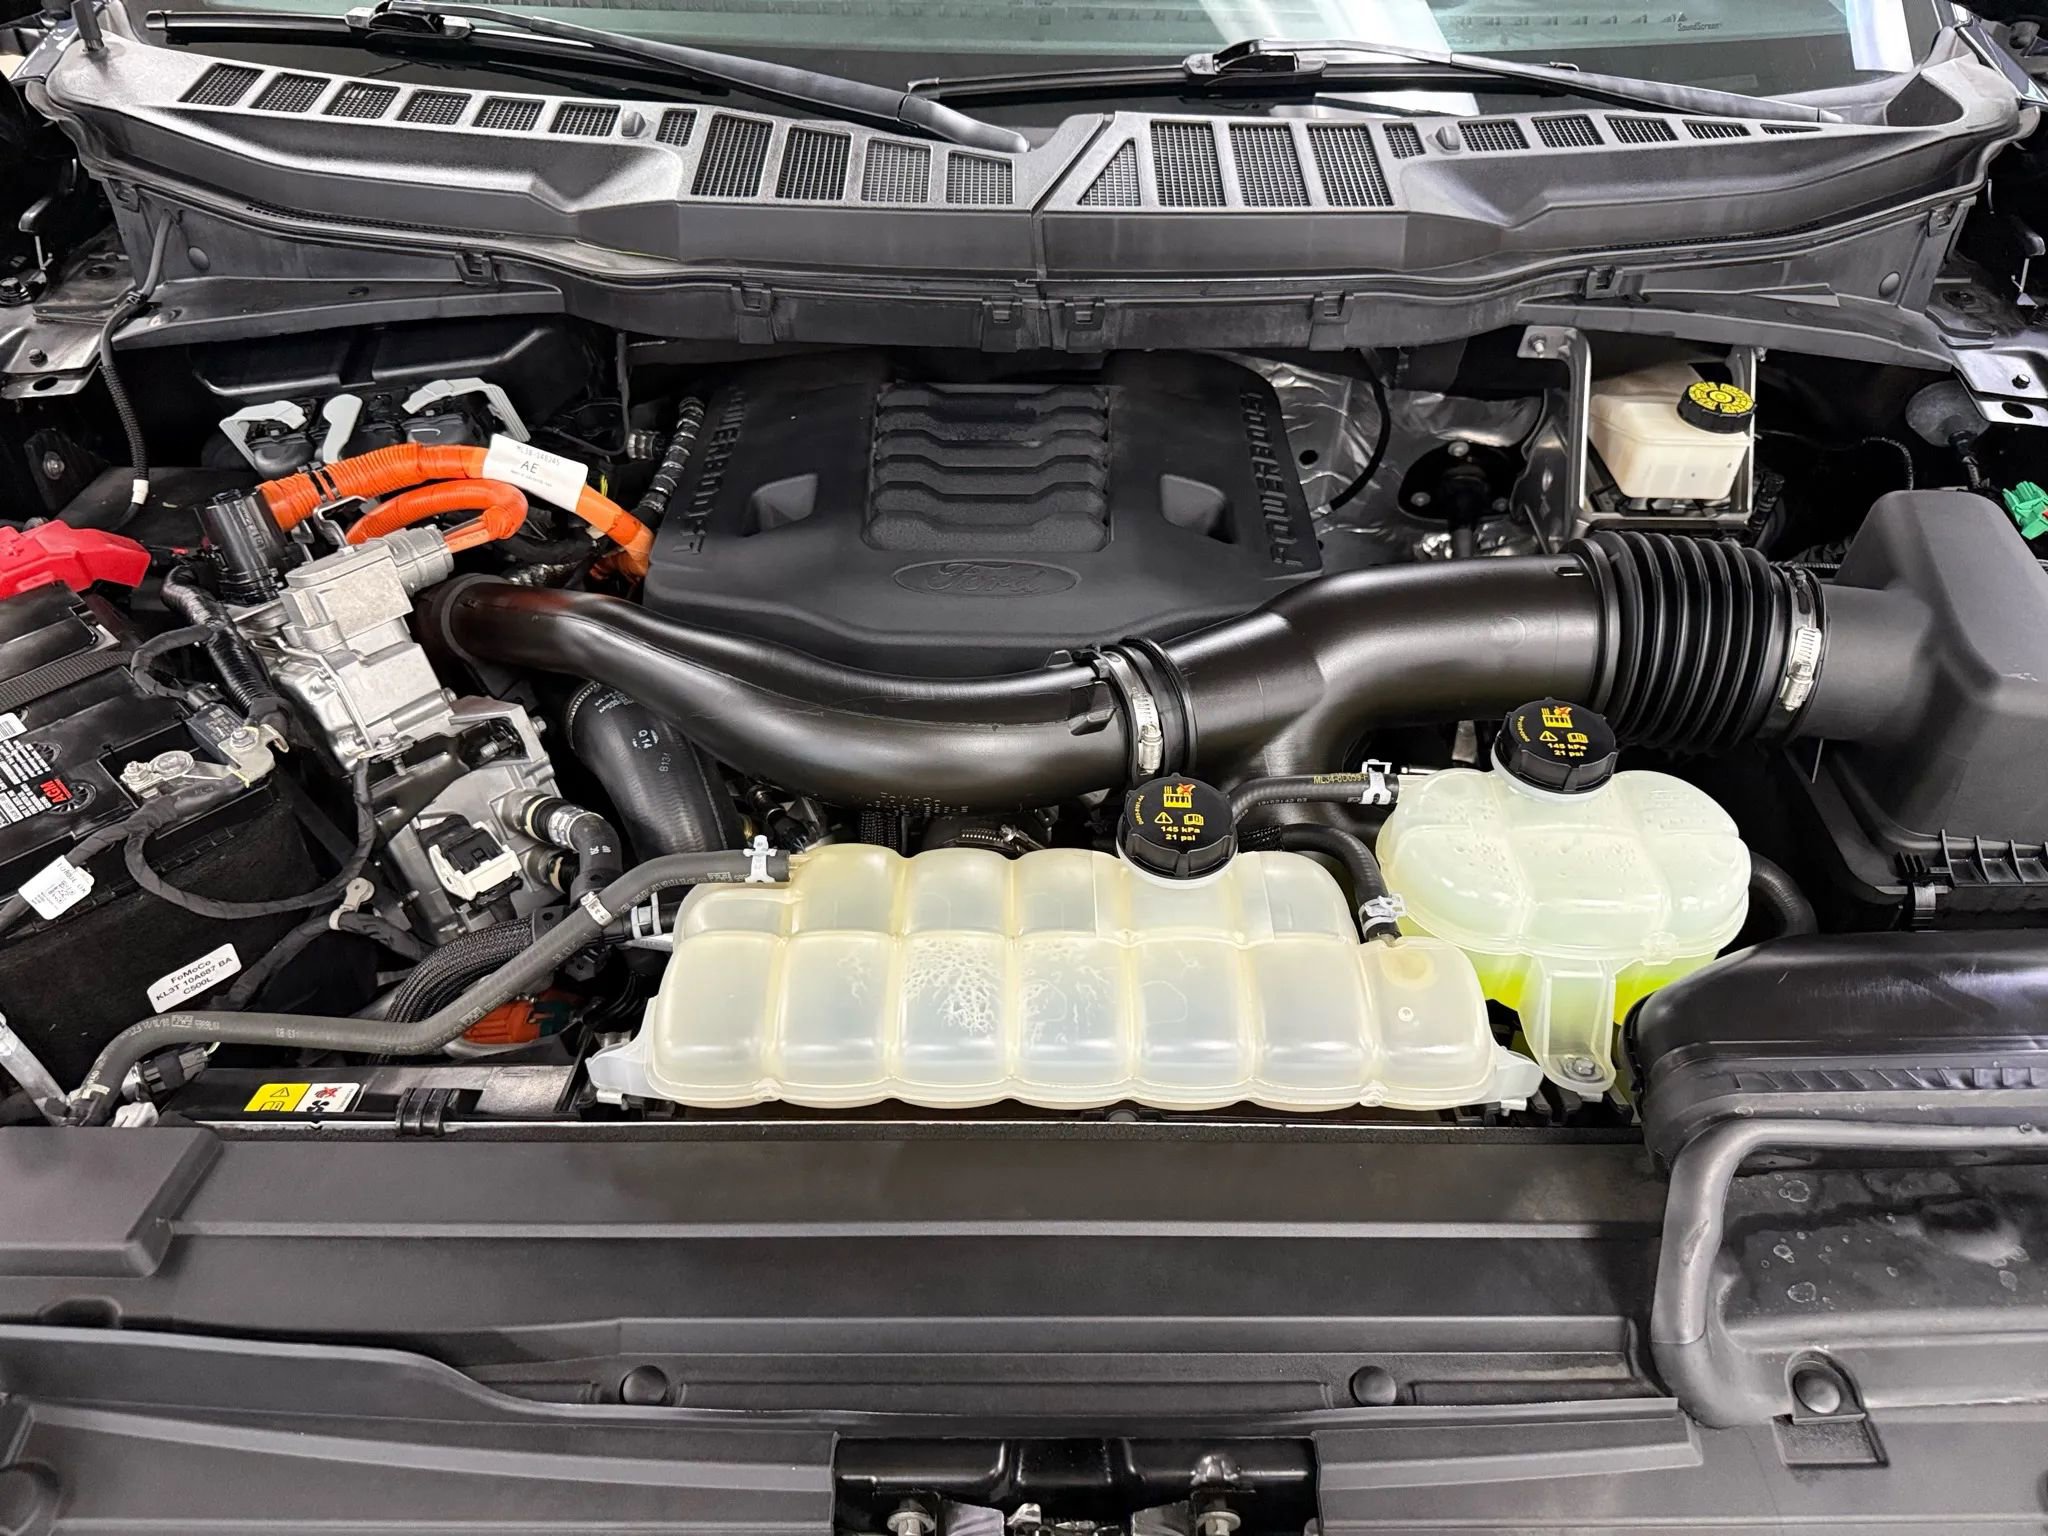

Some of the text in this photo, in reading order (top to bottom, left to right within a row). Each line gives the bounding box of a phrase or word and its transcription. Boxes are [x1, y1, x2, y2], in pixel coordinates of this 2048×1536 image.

[1677, 22, 1721, 31] SoundScreen
[520, 460, 540, 474] AE
[926, 563, 1049, 593] Ford
[1567, 743, 1588, 751] kPa
[40, 780, 67, 803] AGM
[1181, 826, 1201, 834] kPa
[1181, 834, 1196, 842] psi
[156, 983, 181, 1001] KL3T
[218, 957, 233, 968] BA
[170, 960, 212, 984] FoMoCo
